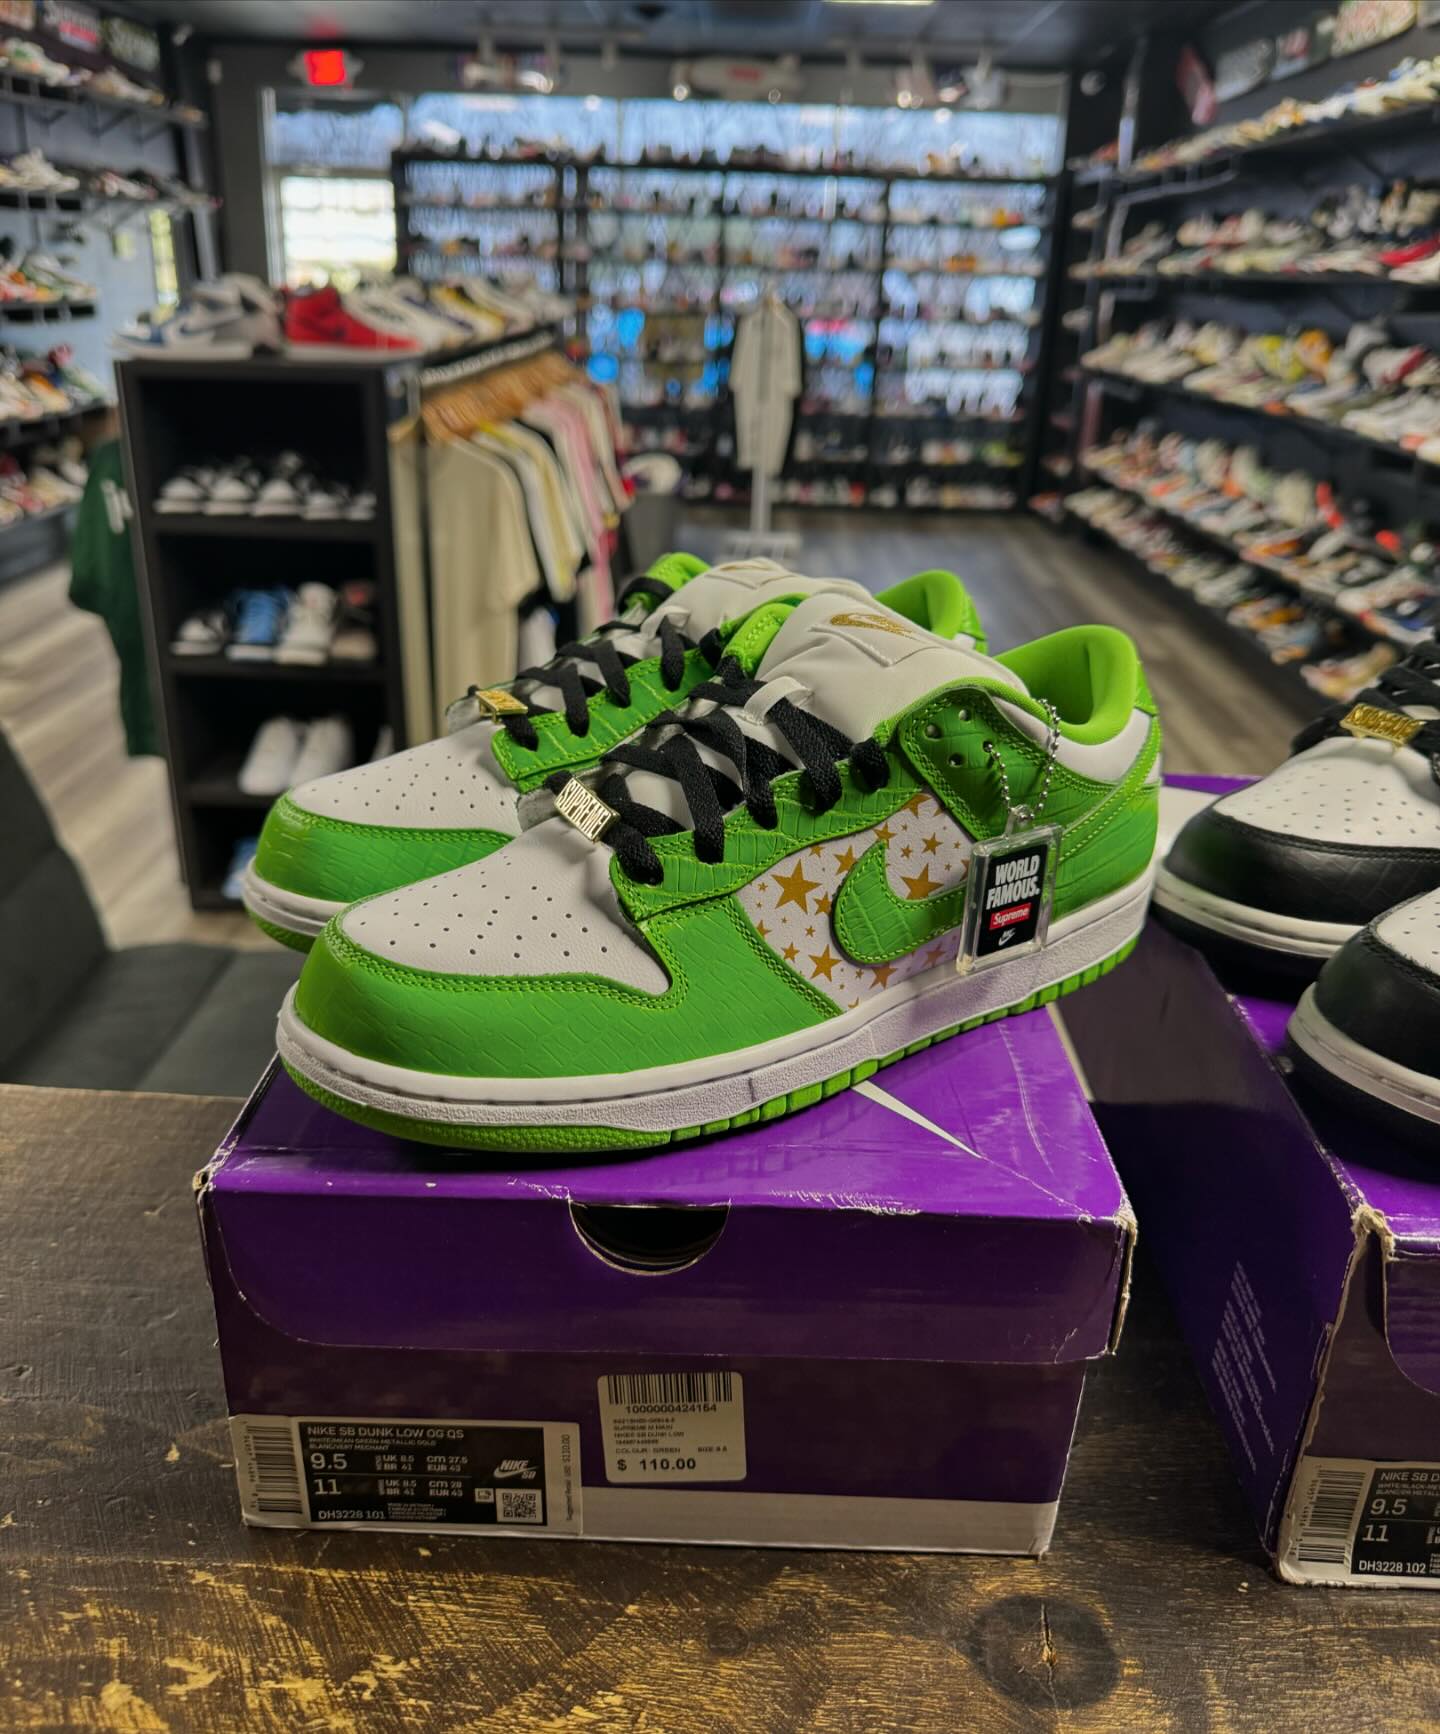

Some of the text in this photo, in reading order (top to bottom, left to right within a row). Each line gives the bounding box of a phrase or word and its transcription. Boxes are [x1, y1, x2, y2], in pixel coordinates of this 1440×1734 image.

[557, 780, 611, 839] SUPREME
[994, 855, 1040, 886] WORLD
[985, 876, 1040, 910] FAMOUS.
[992, 907, 1030, 926] Supreme
[307, 1426, 464, 1439] NIKE SB DUNK LOW OG QS
[310, 1452, 348, 1470] 9.5
[426, 1456, 446, 1464] cm
[500, 1459, 529, 1471] NIKE
[617, 1458, 697, 1471] $ 110.00
[427, 1464, 448, 1472] EUR
[1380, 1472, 1409, 1481] NIKE
[1411, 1472, 1427, 1481] SB
[313, 1478, 342, 1496] 11
[429, 1480, 448, 1488] cm
[429, 1489, 449, 1497] EUR
[1370, 1498, 1408, 1515] 9.5
[318, 1510, 363, 1520] DH3228
[365, 1510, 385, 1520] 101
[1362, 1524, 1389, 1542] 11
[1358, 1560, 1403, 1573] DH3228
[1405, 1562, 1426, 1574] 102
